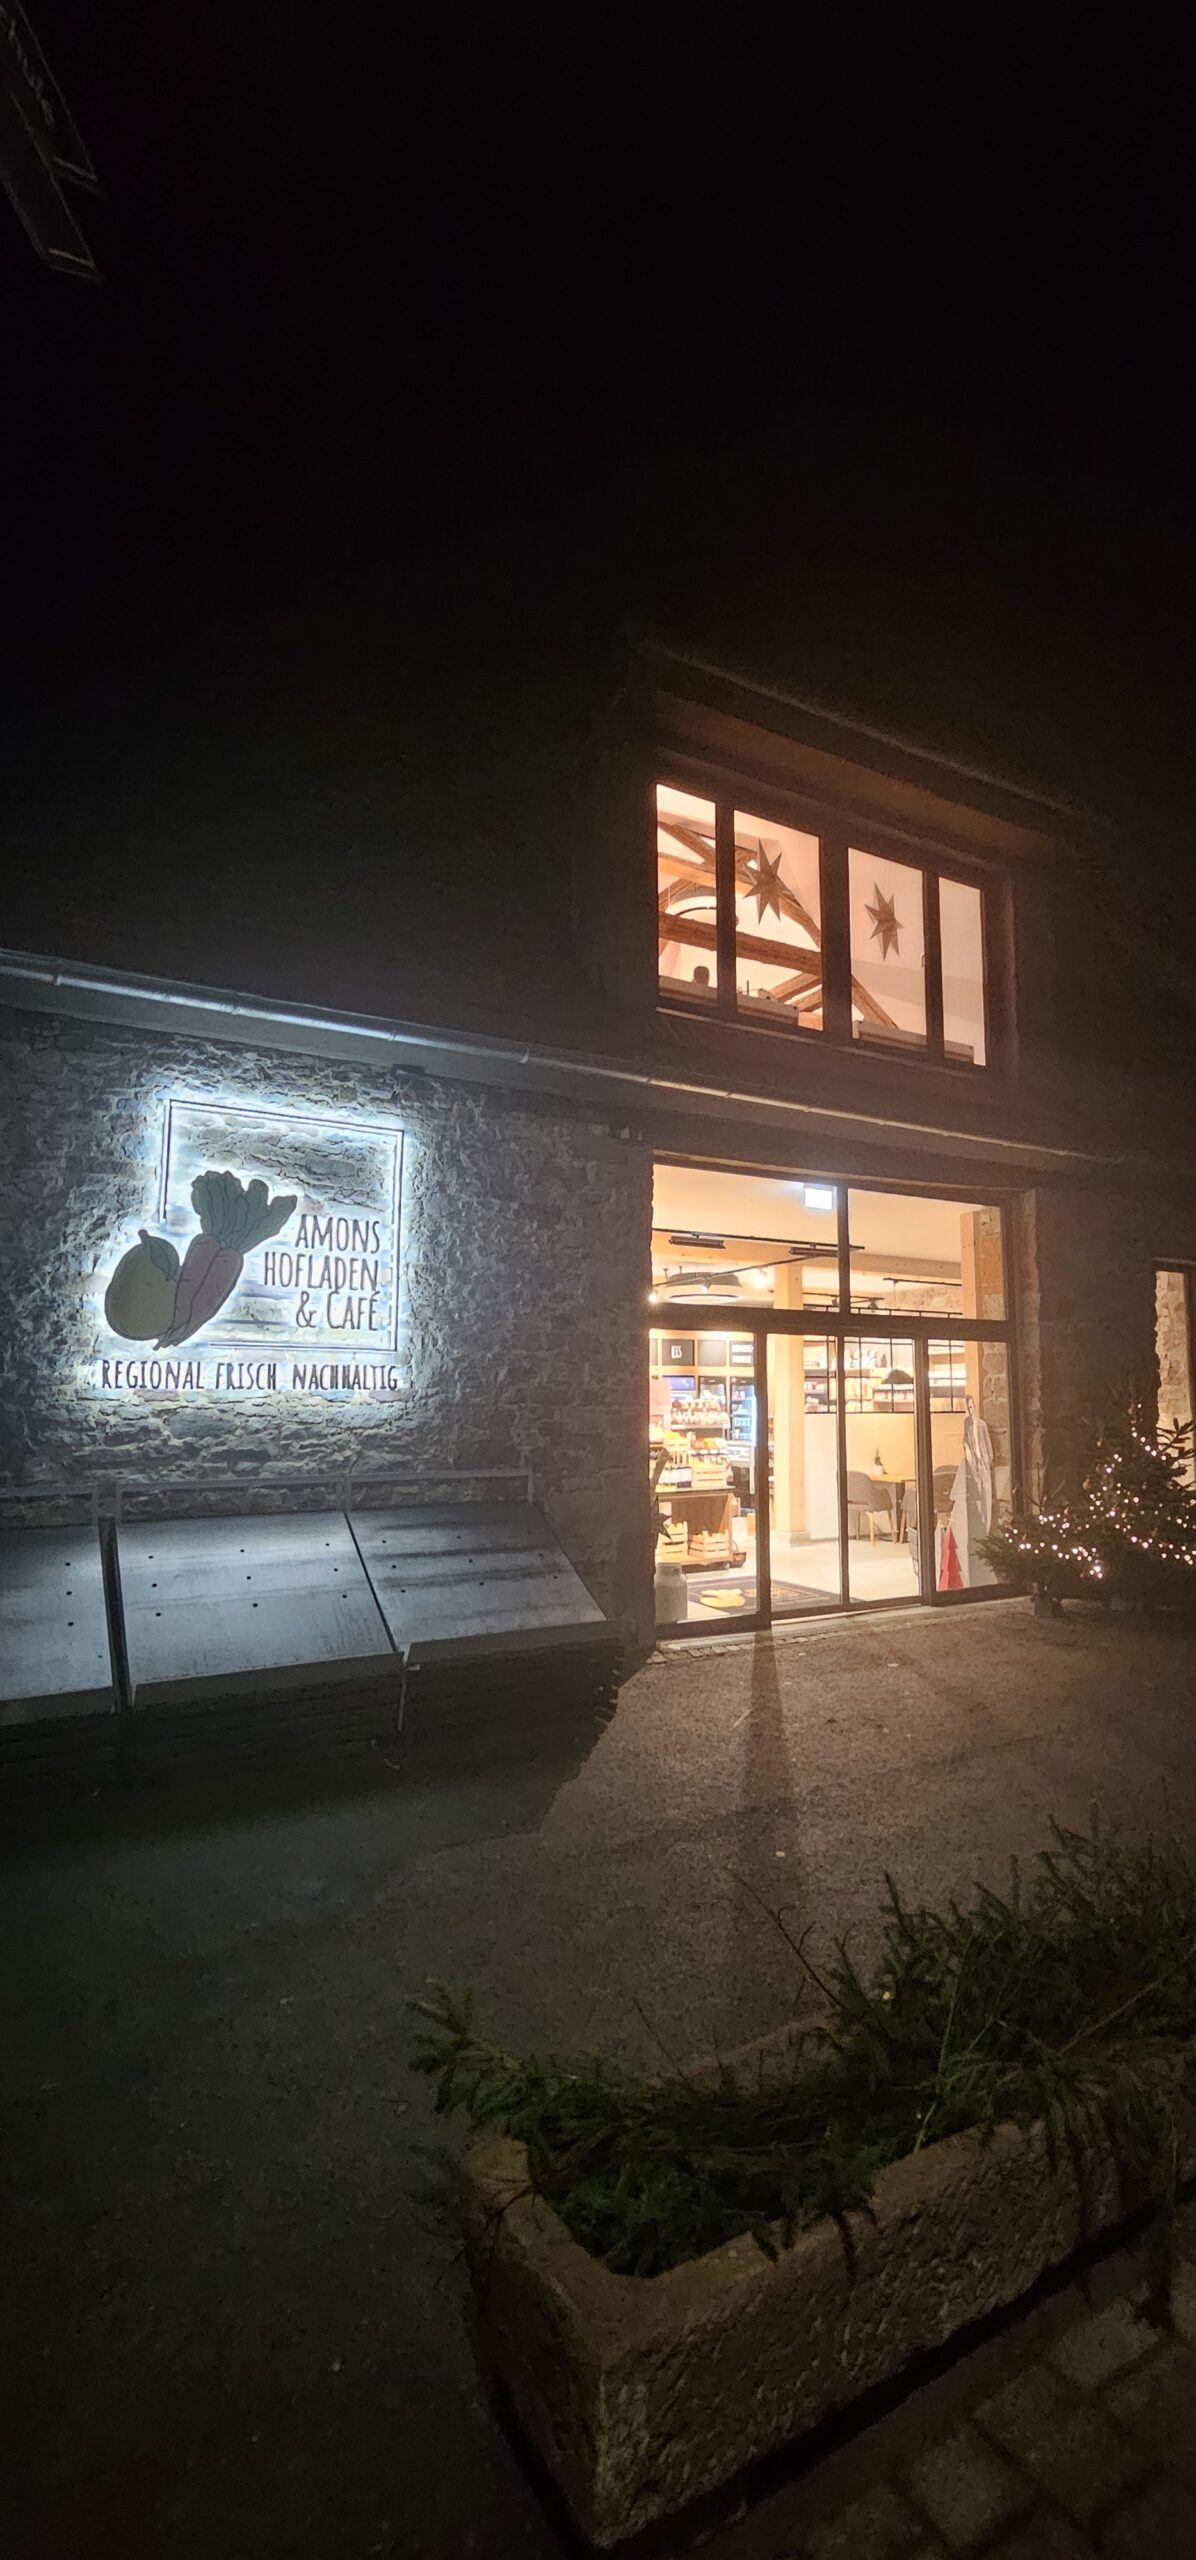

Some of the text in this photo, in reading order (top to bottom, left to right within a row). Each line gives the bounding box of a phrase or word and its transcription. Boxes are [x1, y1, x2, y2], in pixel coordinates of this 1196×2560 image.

[295, 1214, 380, 1254] AMONS
[264, 1251, 379, 1291] HOFLADEN
[296, 1291, 317, 1328] &
[101, 1360, 398, 1391] REGIONAL FRISCH NACHHALTIG
